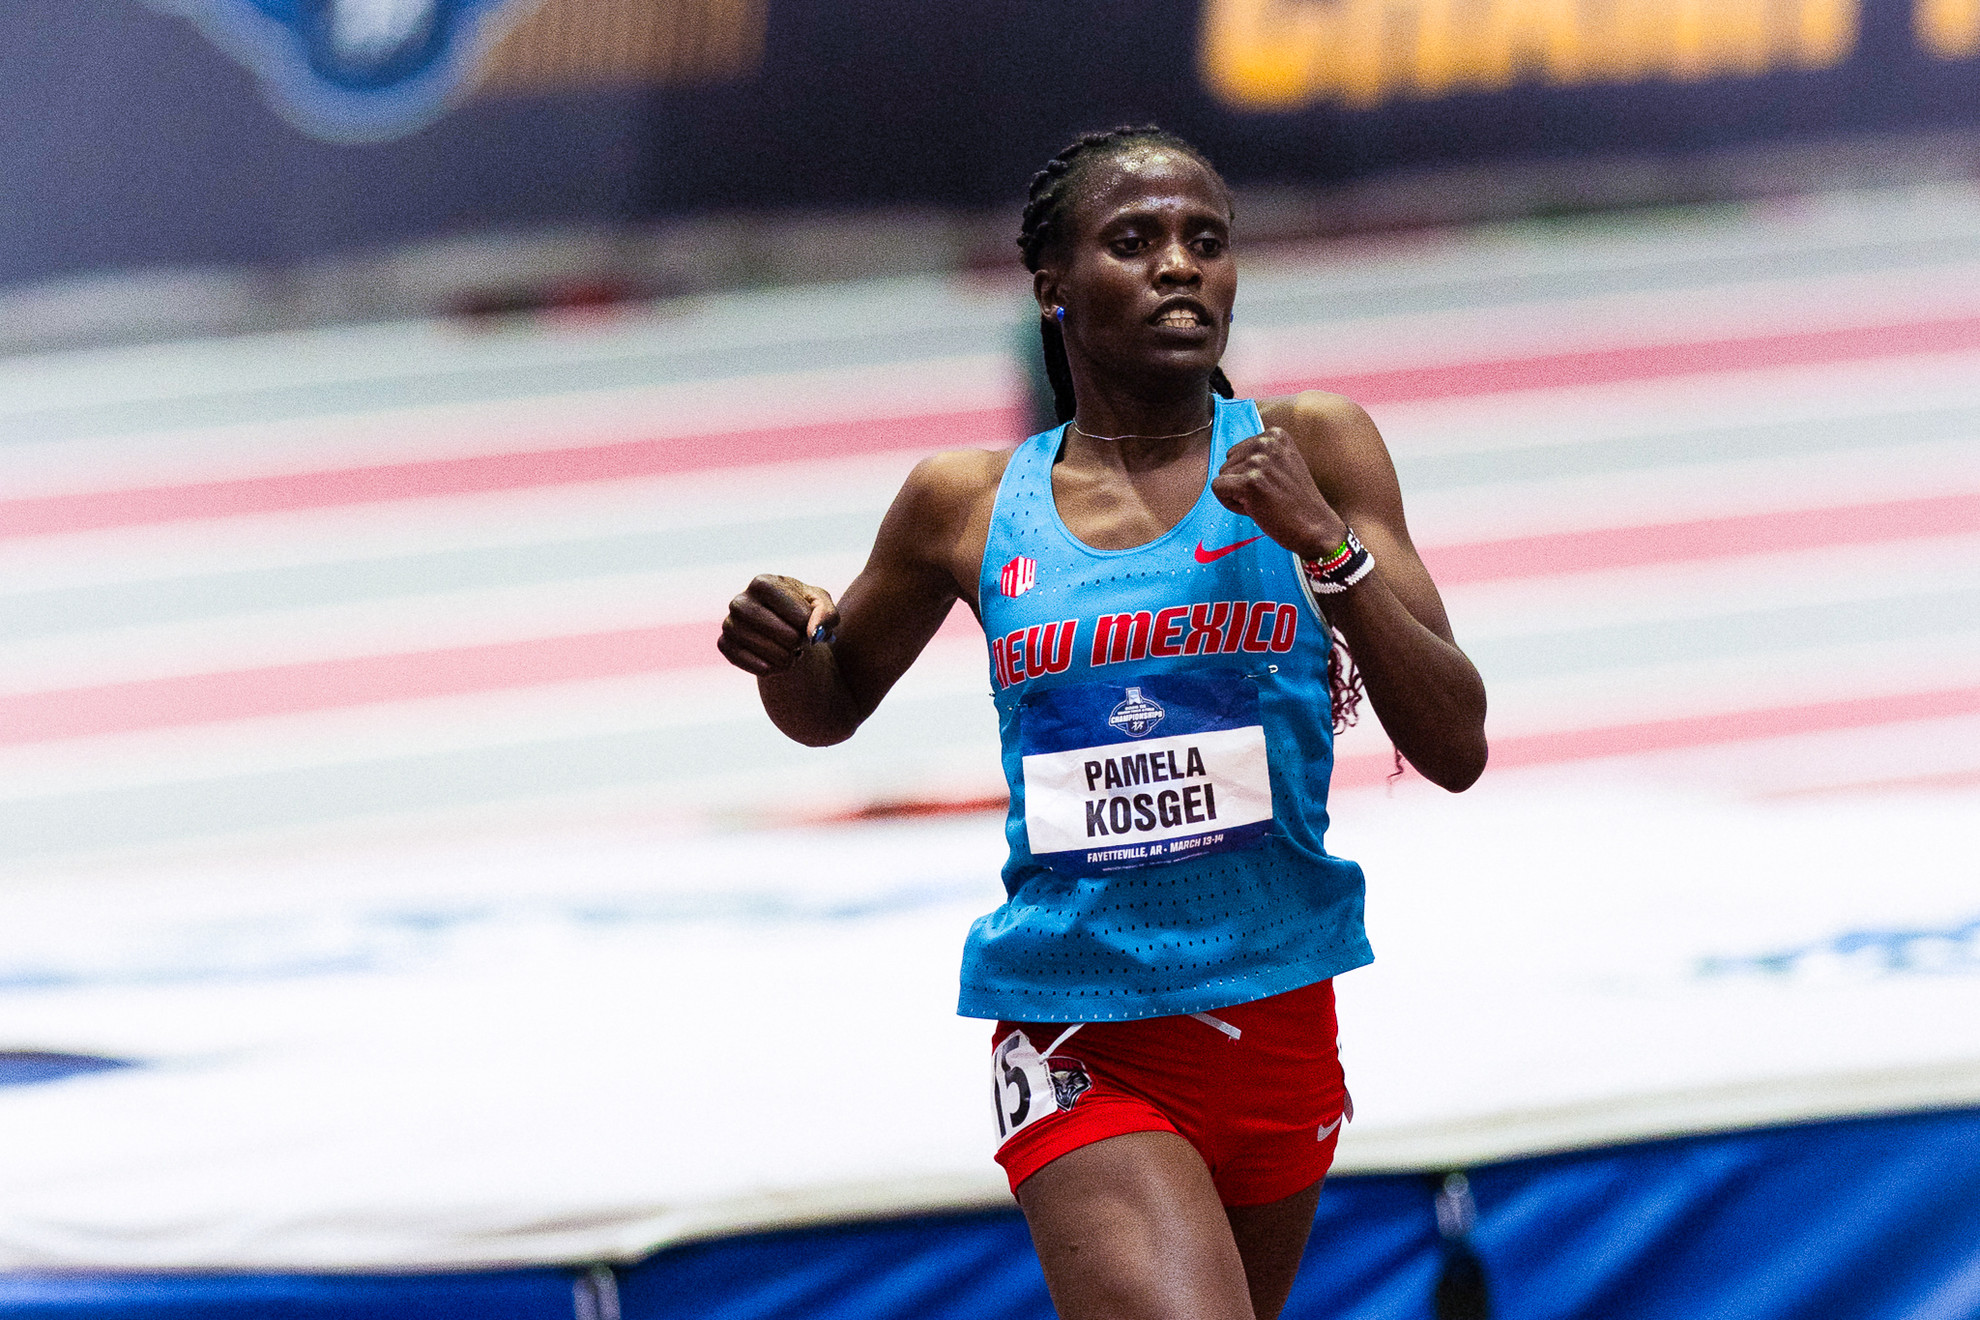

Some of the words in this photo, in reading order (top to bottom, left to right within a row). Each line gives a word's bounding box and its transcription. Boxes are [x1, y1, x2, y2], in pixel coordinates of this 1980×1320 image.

[992, 619, 1079, 690] NEW
[1090, 601, 1298, 667] MEXICO
[1084, 746, 1206, 791] PAMELA
[1085, 783, 1217, 837] KOSGEI
[1087, 846, 1148, 863] FAYETTEVILLE,
[1150, 844, 1163, 856] AR
[1169, 837, 1201, 853] MARCH
[1202, 833, 1224, 846] 13-14
